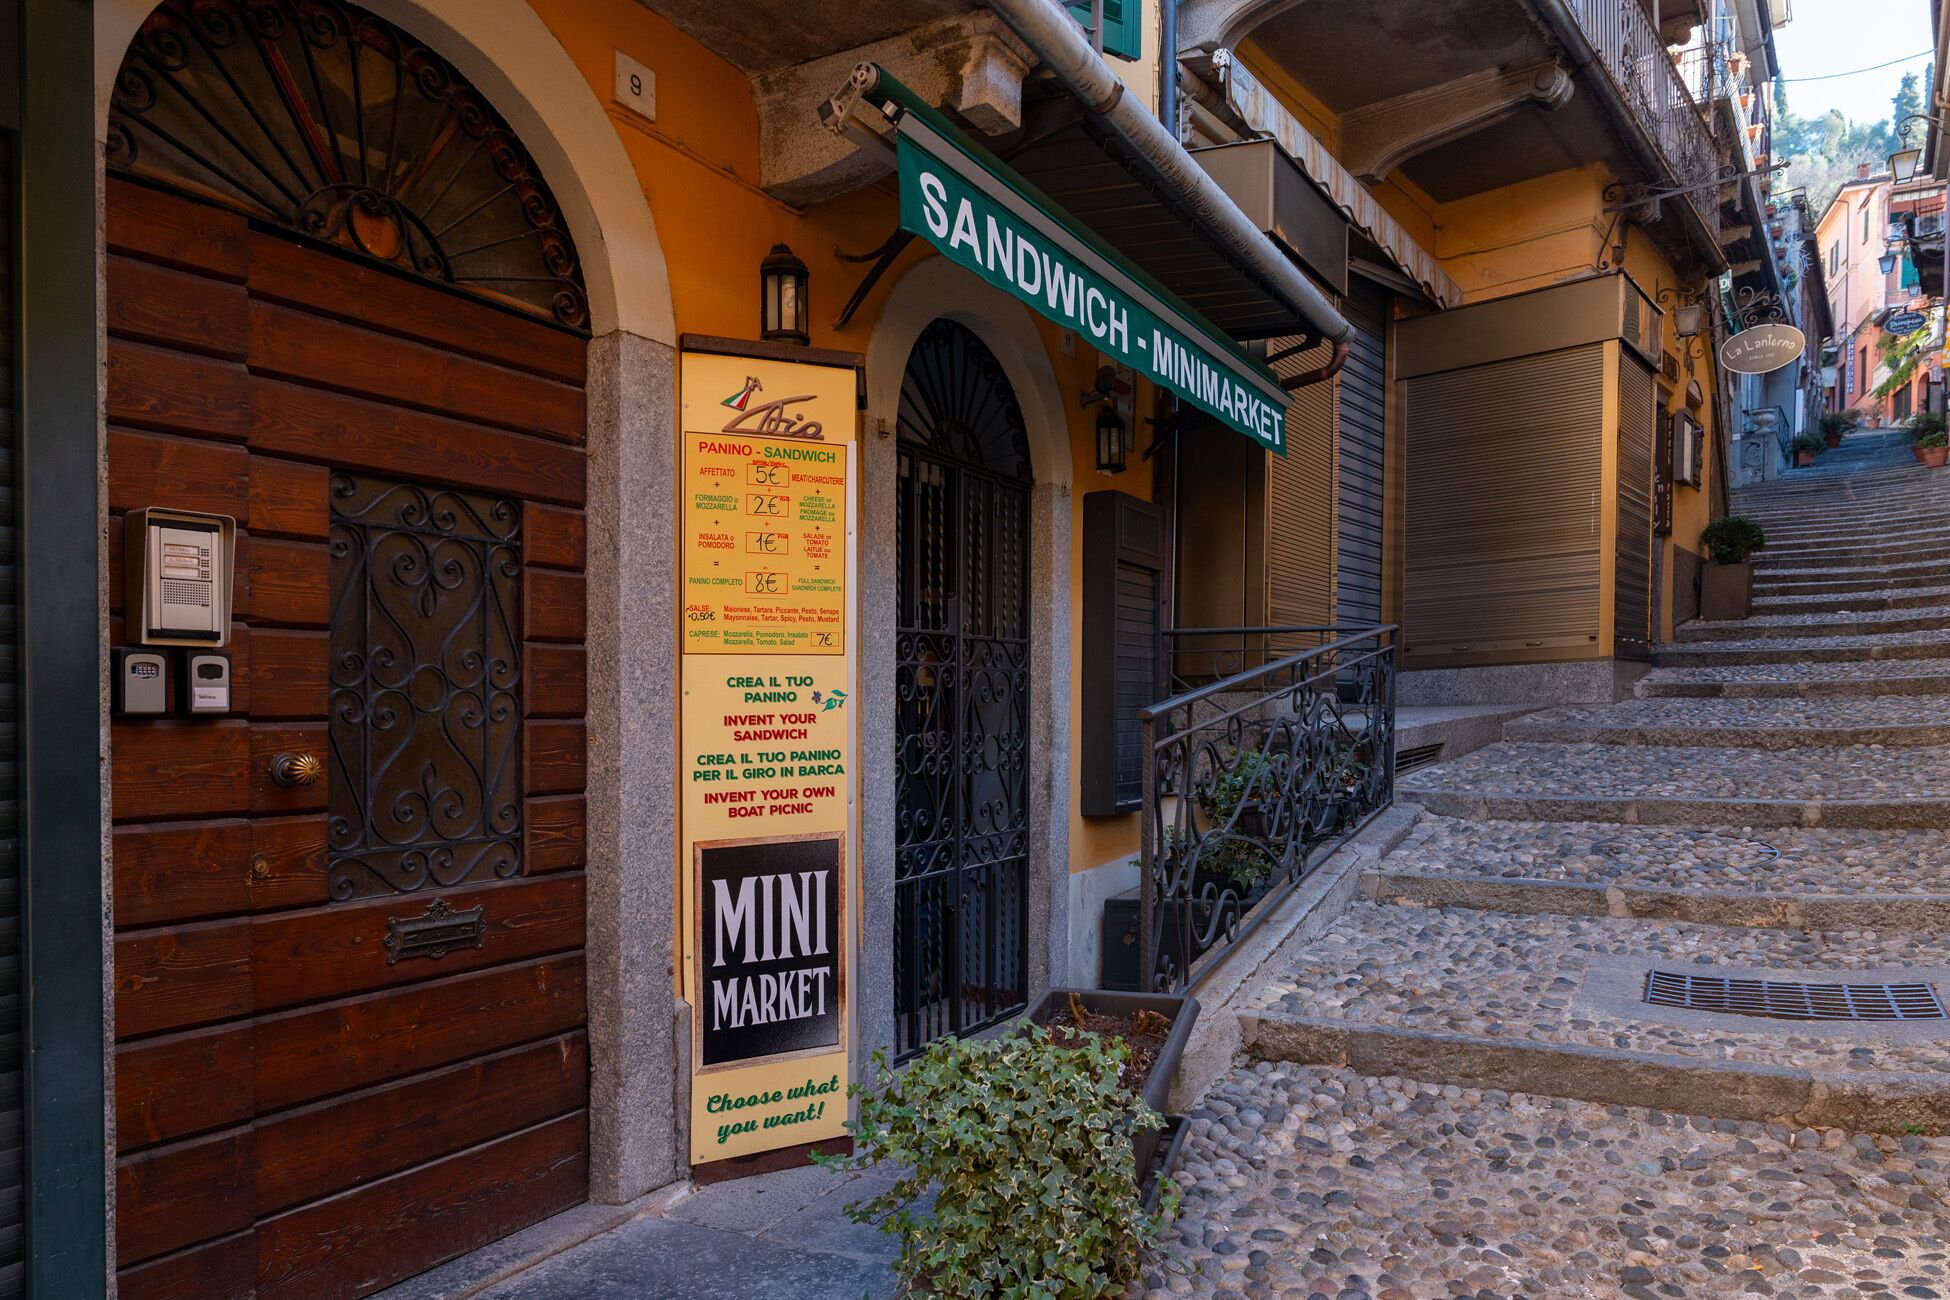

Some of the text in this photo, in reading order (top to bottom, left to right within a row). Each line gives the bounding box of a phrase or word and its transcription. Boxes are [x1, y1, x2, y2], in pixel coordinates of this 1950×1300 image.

[630, 74, 641, 96] 9
[918, 171, 1129, 355] SANDWICH
[1151, 328, 1283, 446] MINIMARKET
[1726, 334, 1796, 360] La Lanterna
[699, 441, 753, 456] PANINO
[764, 446, 836, 463] SANDWICH
[699, 467, 736, 478] AFFETTATO
[755, 466, 780, 485] 5€
[695, 494, 733, 503] FORMAGGIO
[754, 496, 780, 515] 2€
[696, 502, 738, 511] MOZZARELLA
[799, 515, 836, 523] MOZZARELLA
[699, 533, 729, 541] INSALATA
[755, 532, 777, 552] 1€
[698, 541, 735, 549] POMODORO
[689, 577, 743, 586] PANINO COMPLETO
[755, 573, 778, 593] 8€
[689, 604, 711, 612] SALSE:
[820, 608, 840, 616] Senape
[689, 630, 720, 638] CAPRESE:
[787, 631, 808, 639] Insalata
[816, 633, 833, 646] 7€
[726, 676, 814, 688] CREA IL TUO
[744, 691, 797, 703] PANINO
[723, 713, 817, 726] INVENT YOUR
[733, 729, 808, 741] SANDWICH
[697, 749, 841, 765] CREA IL TUO PANINO
[693, 764, 845, 781] PER IL GIRO IN BARCA
[704, 786, 836, 804] INVENT YOUR OWN
[728, 802, 814, 818] BOAT PICNIC
[711, 869, 830, 967] MINI
[711, 966, 831, 1031] MARKET
[706, 1074, 840, 1115] Choose what
[717, 1101, 825, 1145] you want!
